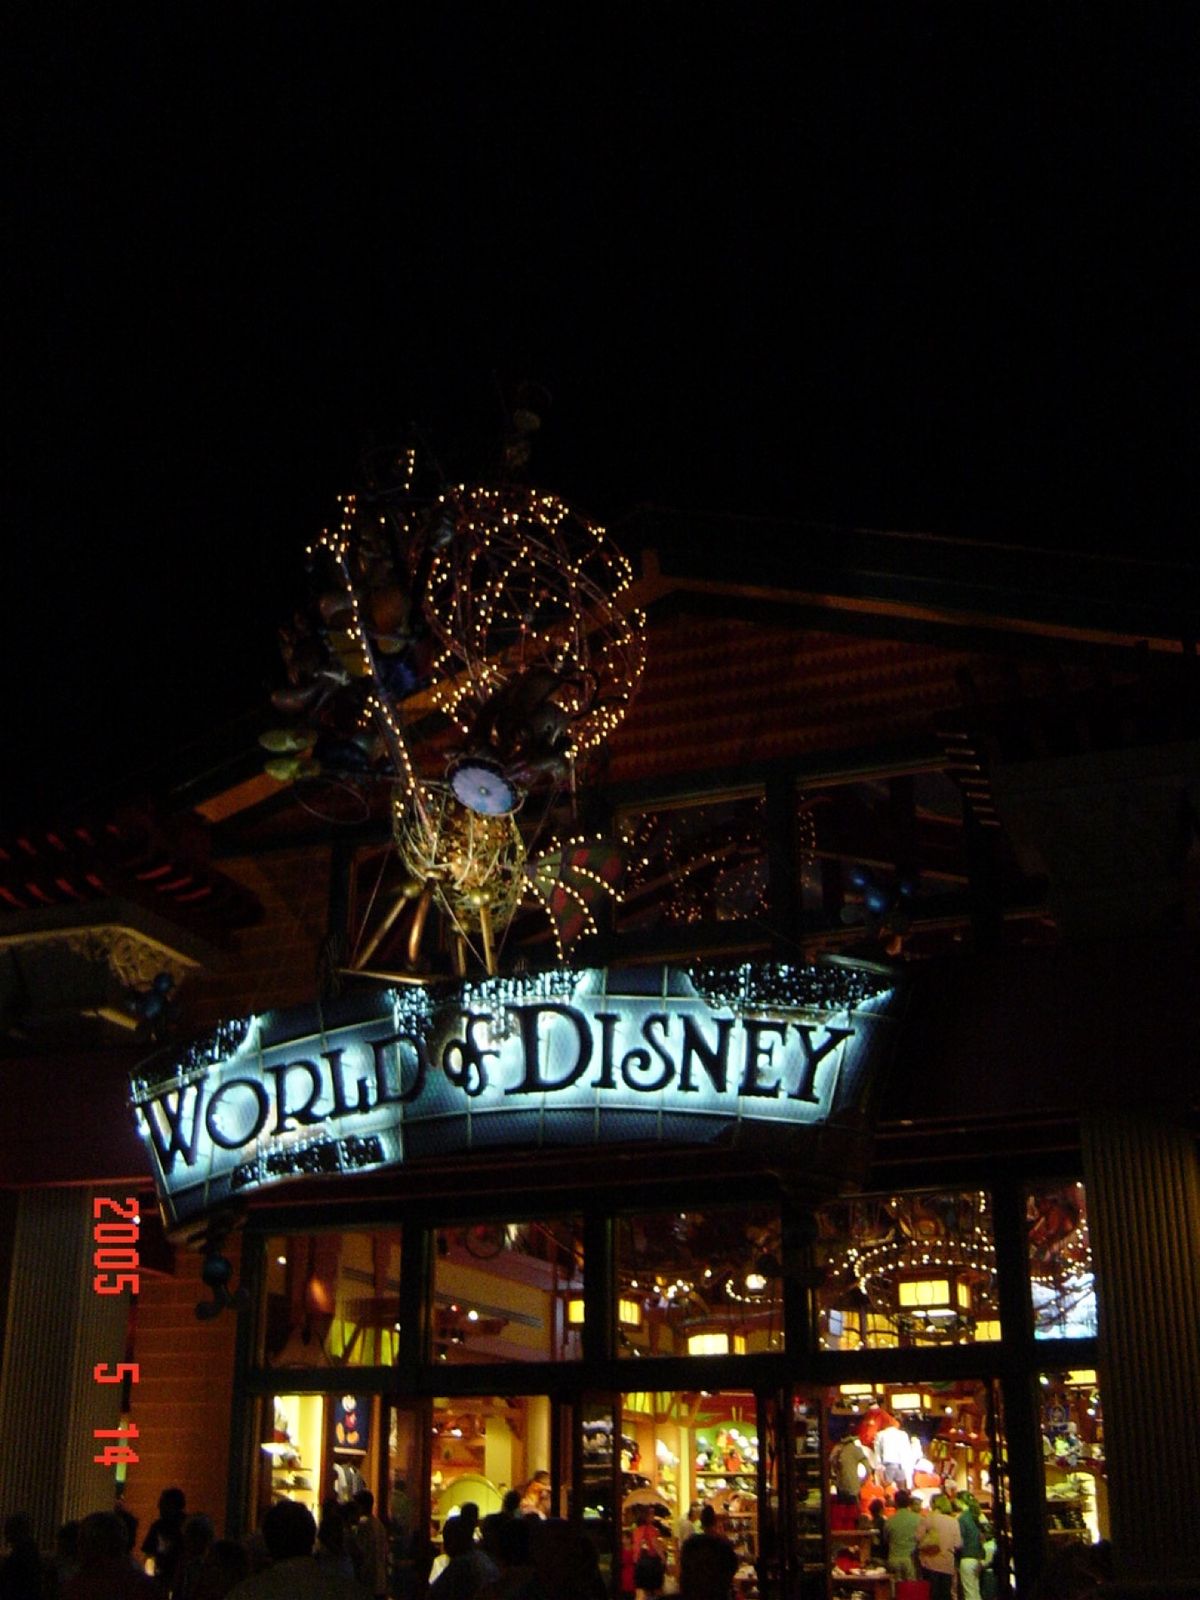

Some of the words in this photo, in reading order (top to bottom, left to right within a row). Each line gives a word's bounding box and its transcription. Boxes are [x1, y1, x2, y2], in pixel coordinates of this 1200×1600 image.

[137, 1033, 426, 1175] WORLD
[443, 1010, 502, 1097] of
[504, 1002, 855, 1103] DISNEY
